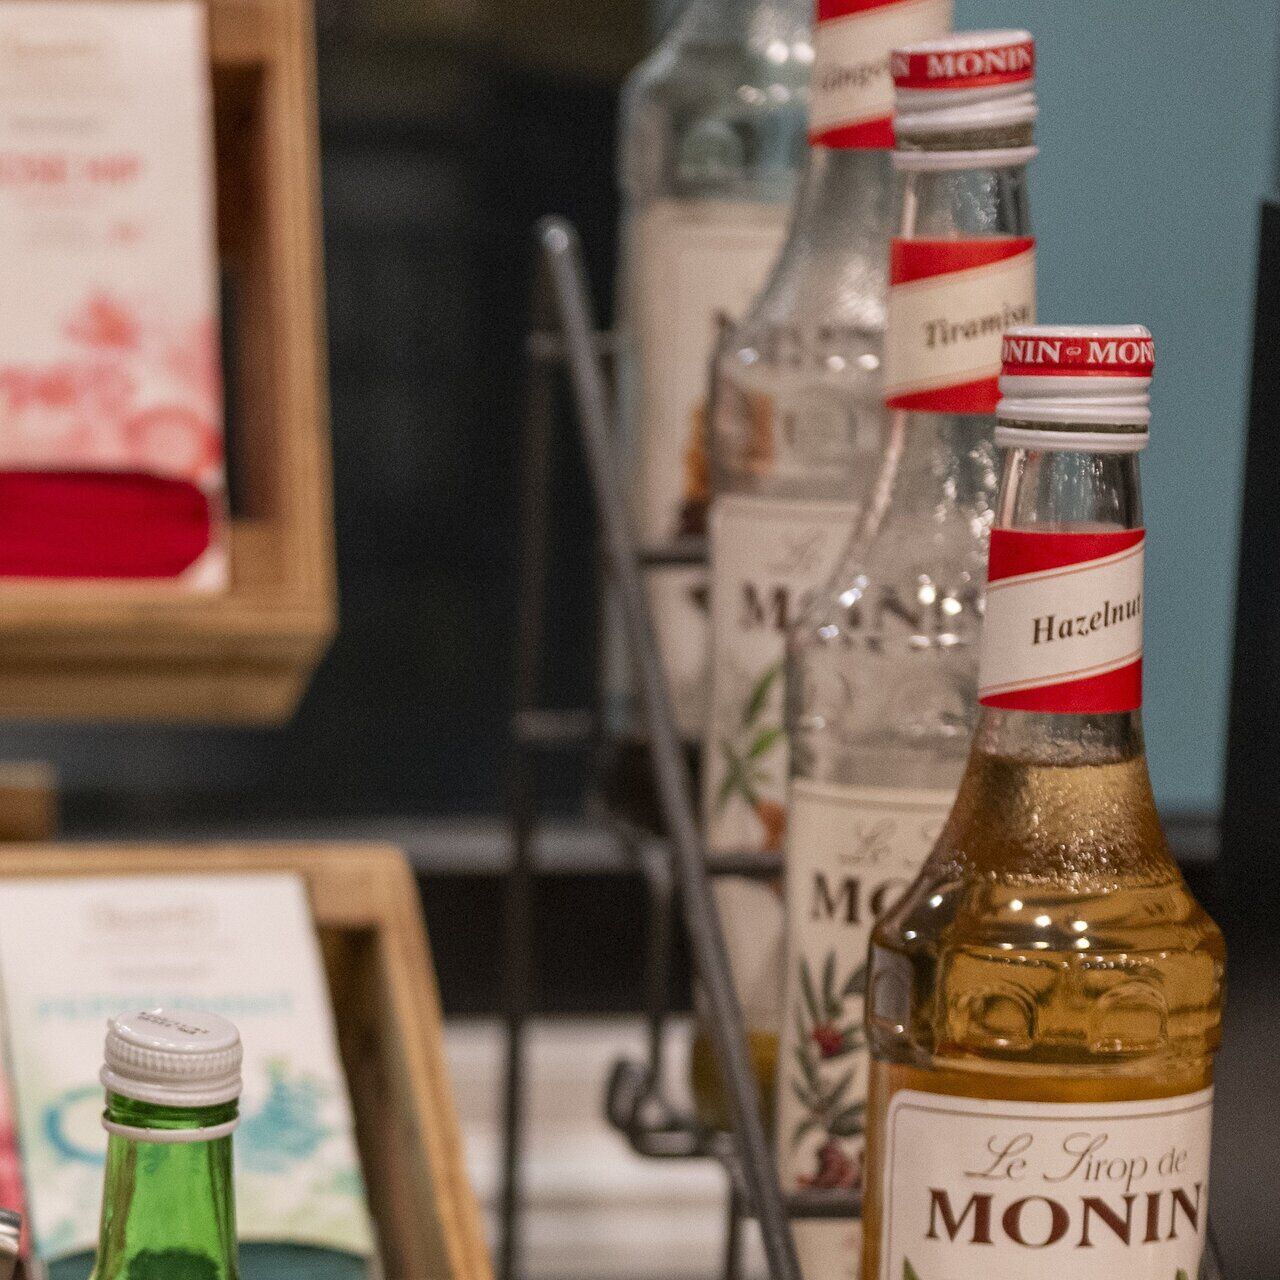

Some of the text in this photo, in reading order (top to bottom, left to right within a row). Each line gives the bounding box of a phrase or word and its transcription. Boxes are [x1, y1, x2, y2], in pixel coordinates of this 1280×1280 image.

[926, 48, 1032, 77] MONIN
[1002, 341, 1062, 365] NIN
[963, 1132, 1188, 1191] Le Sirop de
[925, 1182, 1203, 1249] MONIN
